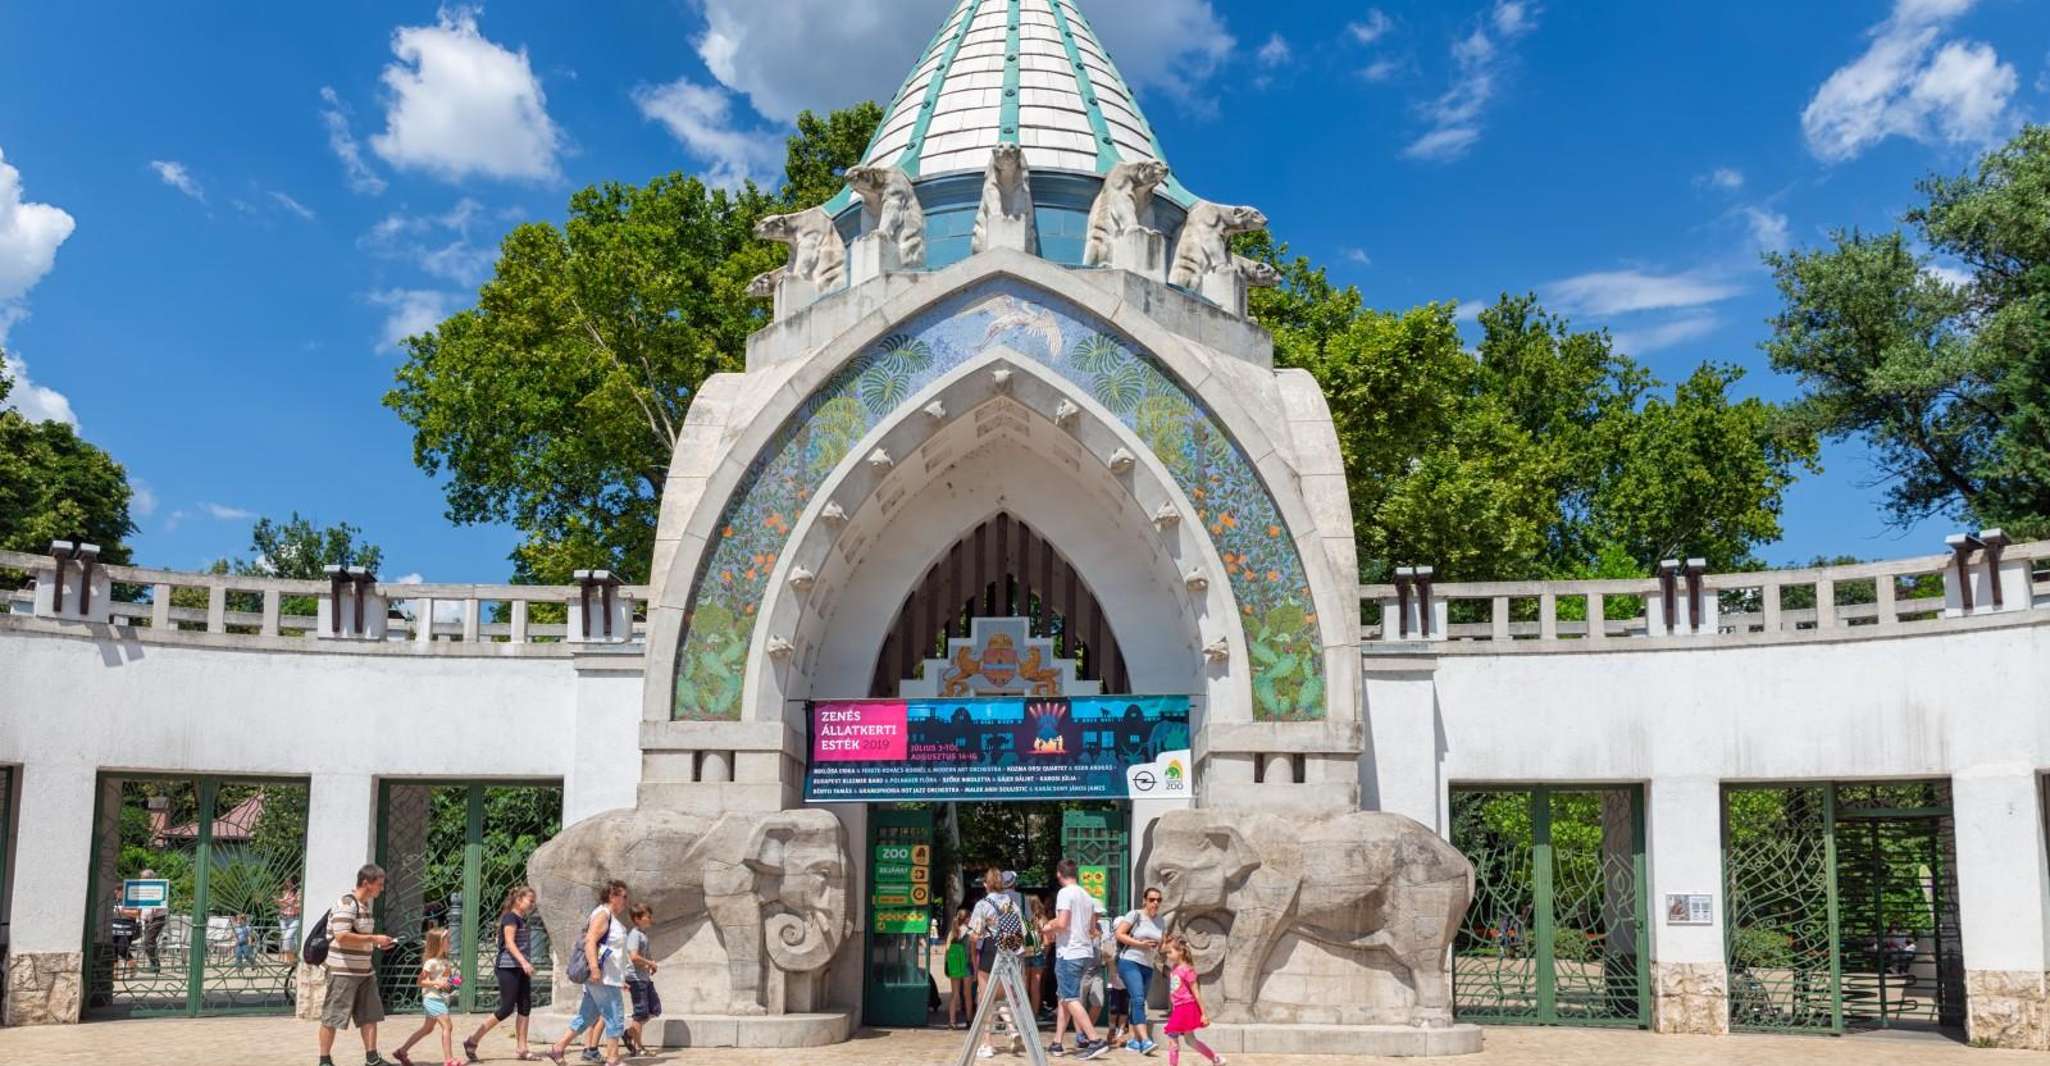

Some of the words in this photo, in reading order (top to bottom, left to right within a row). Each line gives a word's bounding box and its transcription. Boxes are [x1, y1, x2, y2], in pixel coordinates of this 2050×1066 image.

[821, 710, 861, 722] ZENÉS
[821, 723, 896, 737] ÁLLATKERTI
[821, 738, 860, 750] ESTÉK
[863, 739, 891, 750] 2019
[911, 752, 957, 761] AUGUSZTUS
[882, 848, 908, 859] ZOO
